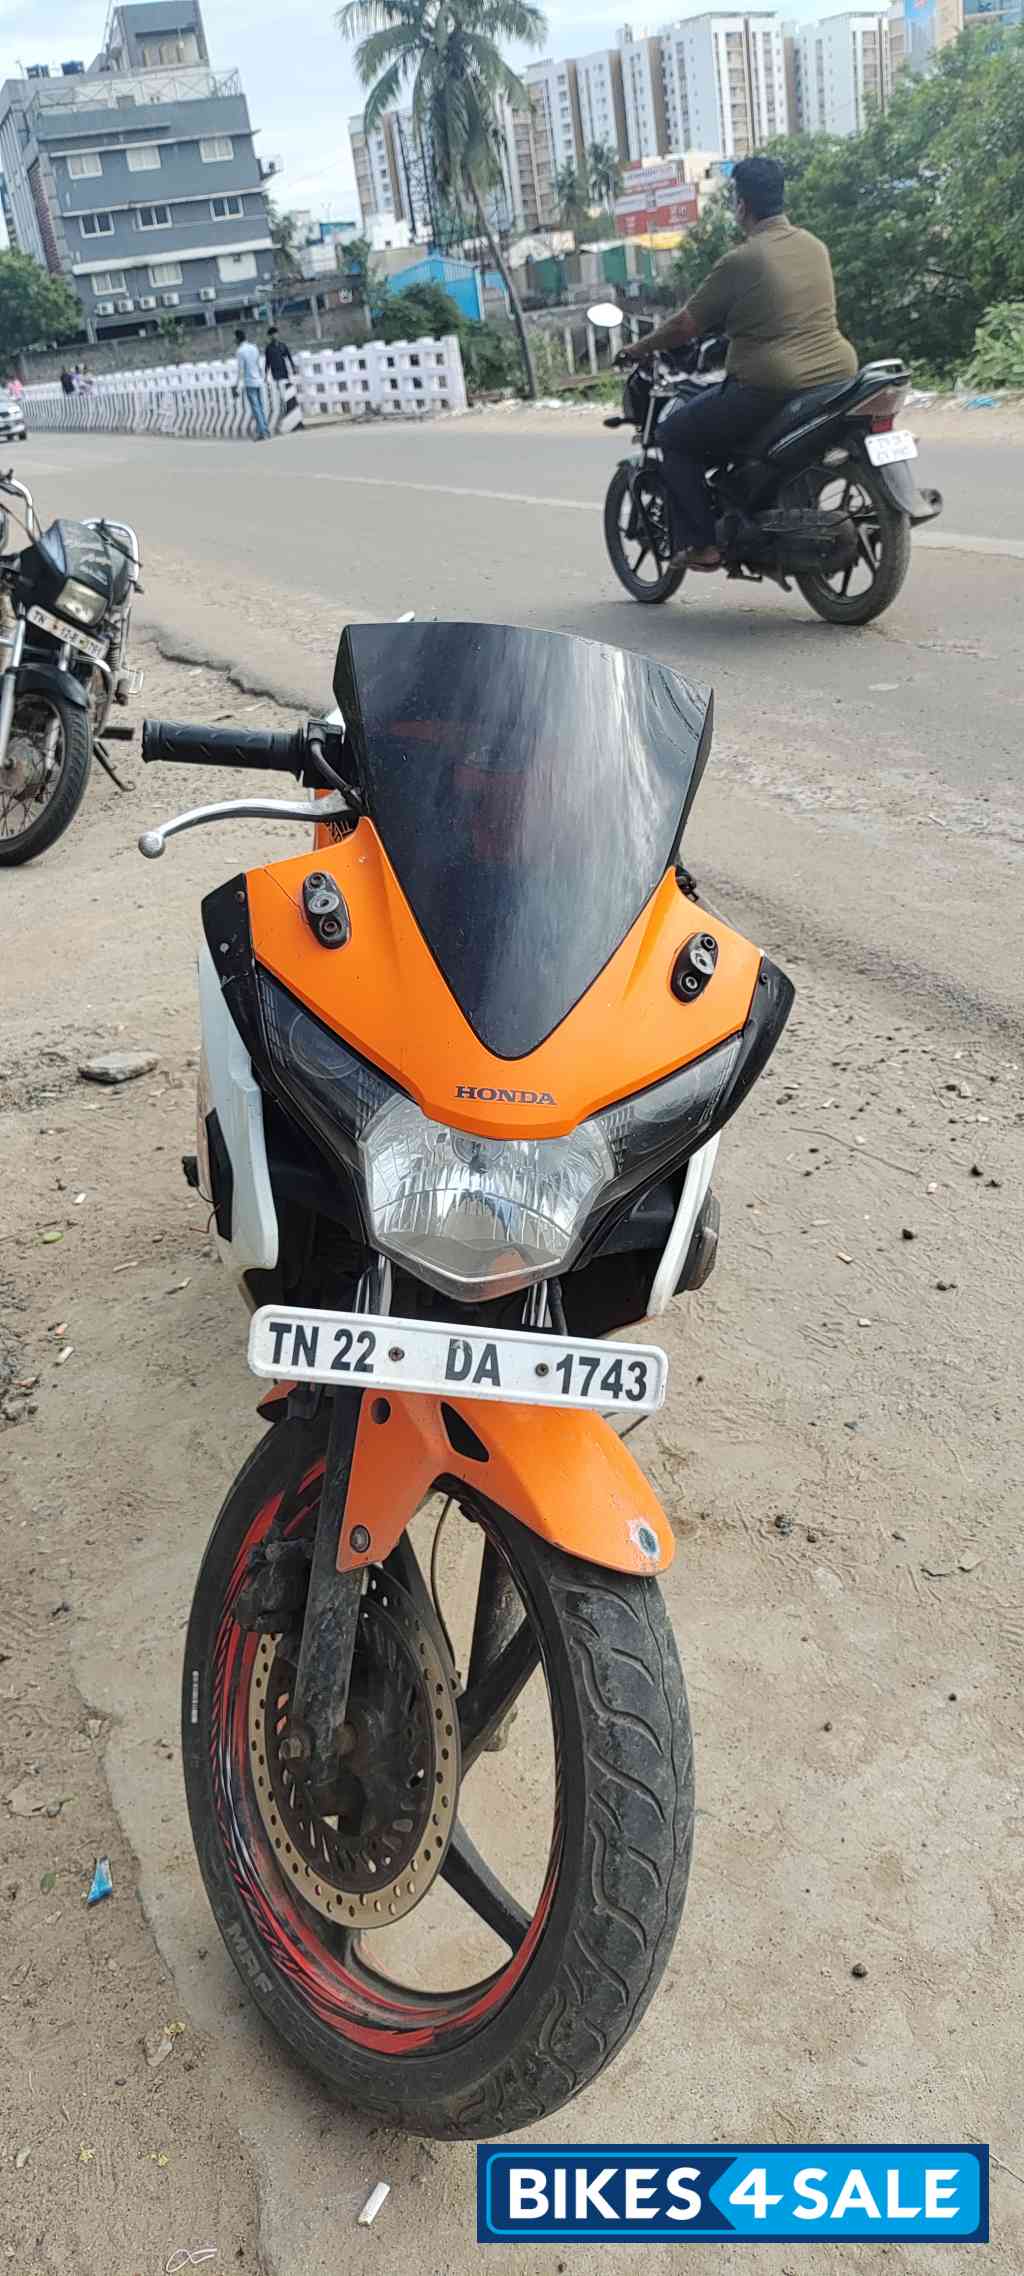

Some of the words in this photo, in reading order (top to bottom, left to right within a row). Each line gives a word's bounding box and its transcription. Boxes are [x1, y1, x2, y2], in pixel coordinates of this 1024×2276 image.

[455, 1085, 559, 1106] HONDA
[268, 1322, 320, 1368] TN
[330, 1328, 377, 1373] 22
[444, 1338, 501, 1387] DA
[556, 1352, 649, 1402] 1743
